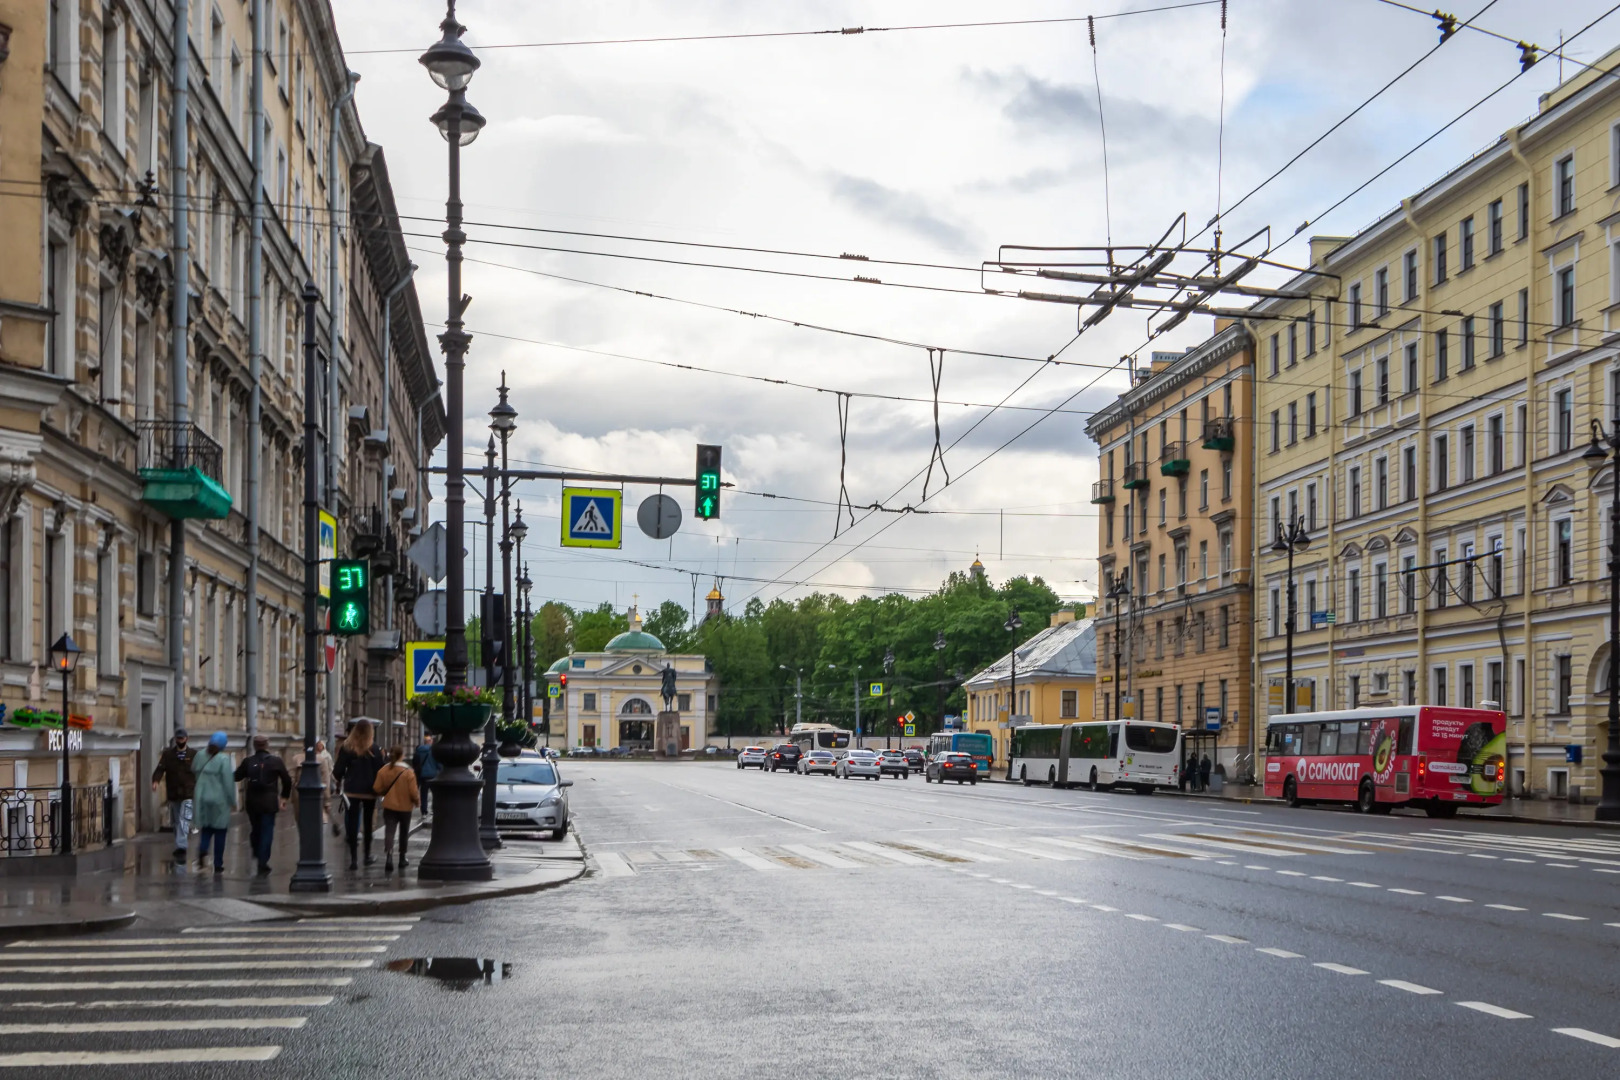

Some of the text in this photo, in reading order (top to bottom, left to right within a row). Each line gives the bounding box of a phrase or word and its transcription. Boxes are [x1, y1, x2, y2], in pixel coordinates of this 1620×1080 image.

[701, 473, 717, 489] 37
[339, 566, 363, 590] 37
[48, 729, 83, 751] РЕСТРАН
